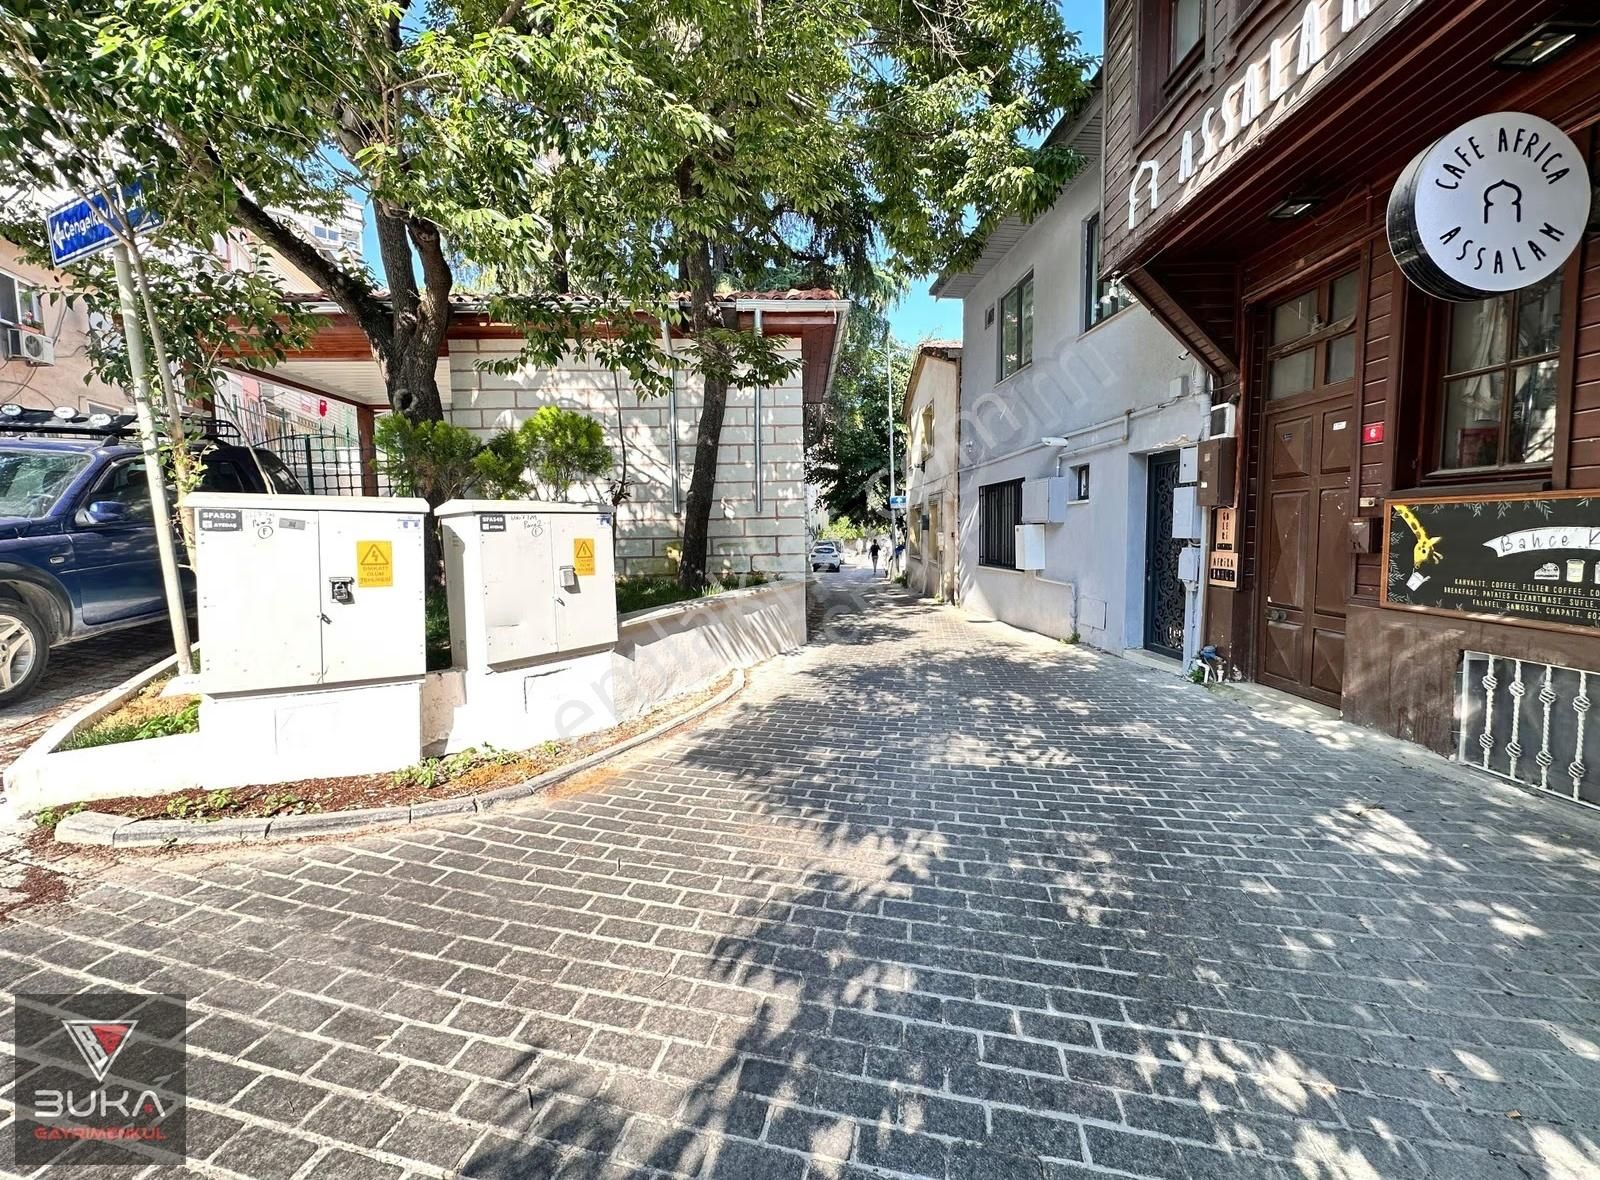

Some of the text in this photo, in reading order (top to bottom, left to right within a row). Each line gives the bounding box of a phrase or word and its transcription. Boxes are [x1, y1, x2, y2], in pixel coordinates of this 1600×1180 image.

[1435, 127, 1570, 190] CAFE AFRICA
[1439, 222, 1565, 274] ASSALAM
[1370, 428, 1376, 438] 6
[1522, 583, 1549, 592] FILTER
[1482, 590, 1511, 599] PATATES
